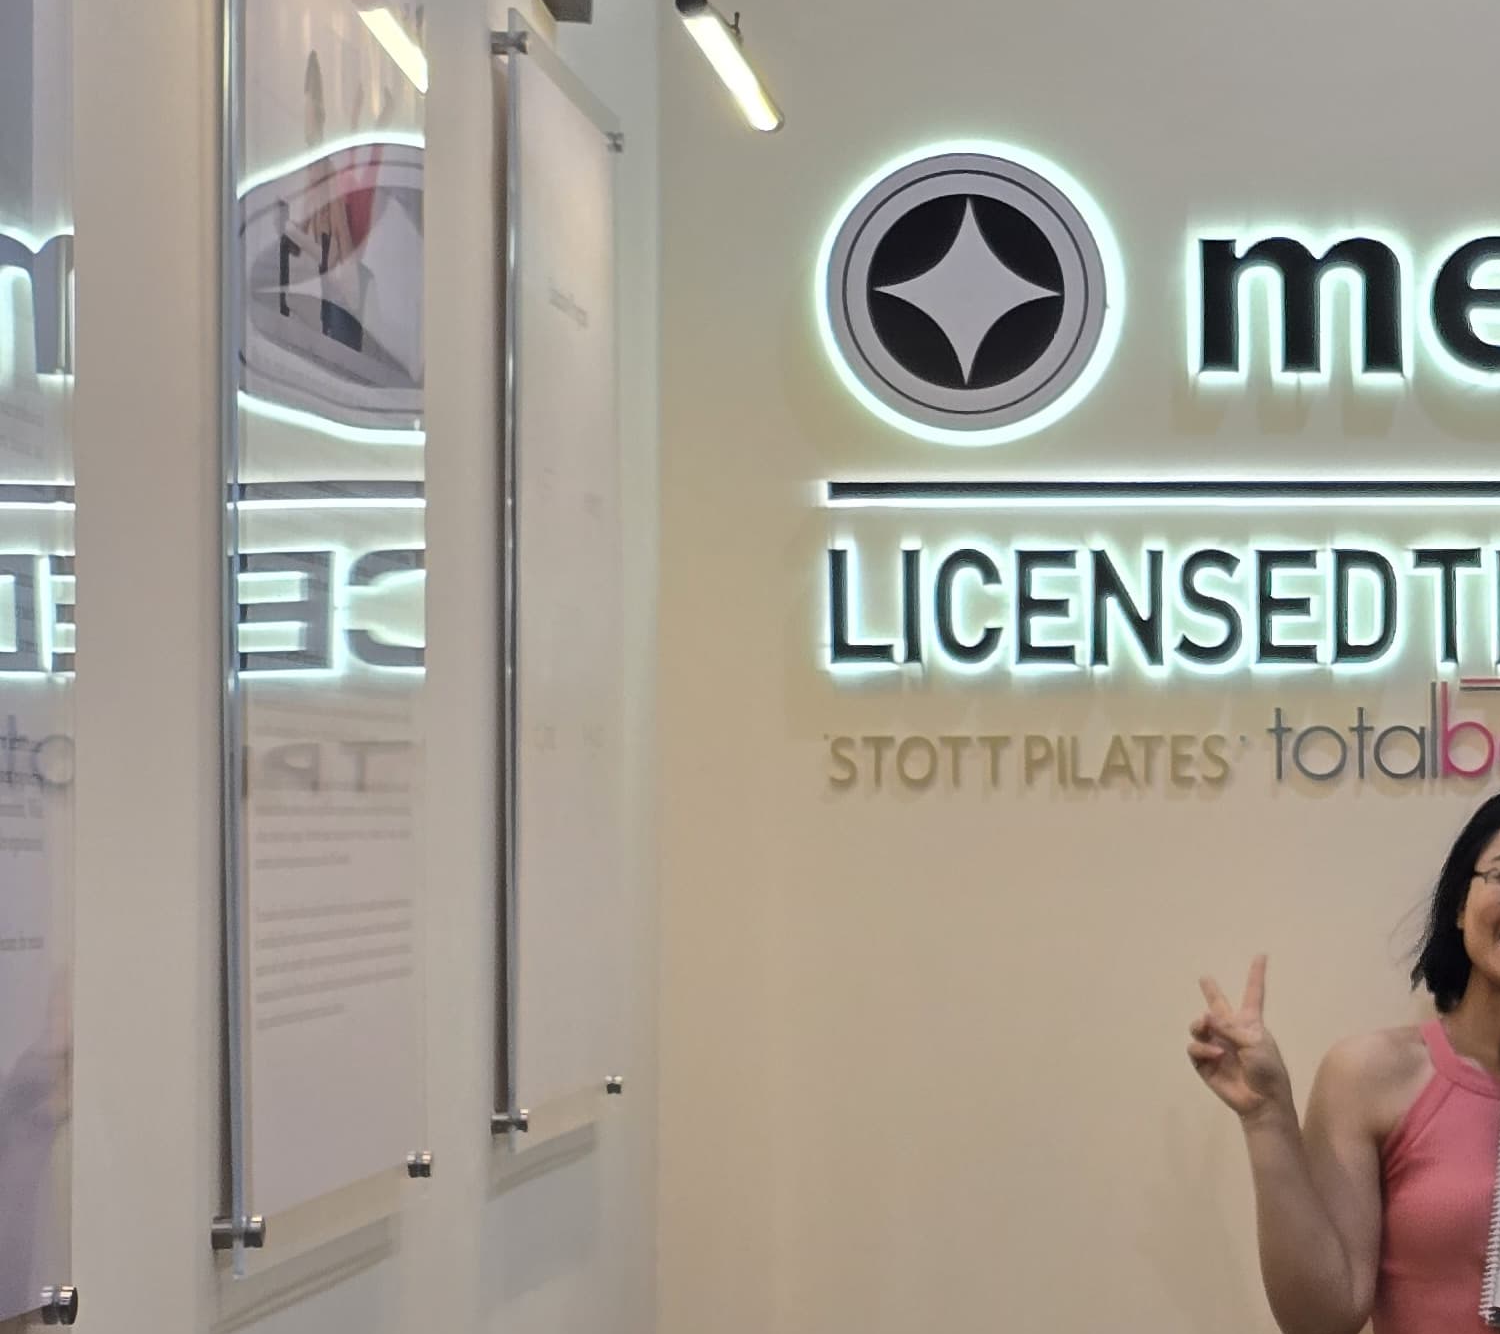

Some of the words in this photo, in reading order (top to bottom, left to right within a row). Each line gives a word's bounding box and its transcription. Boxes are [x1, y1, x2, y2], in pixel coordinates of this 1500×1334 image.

[827, 547, 1398, 666] LICENSED
[828, 734, 1011, 789] STOTT
[1023, 733, 1231, 790] PILATES
